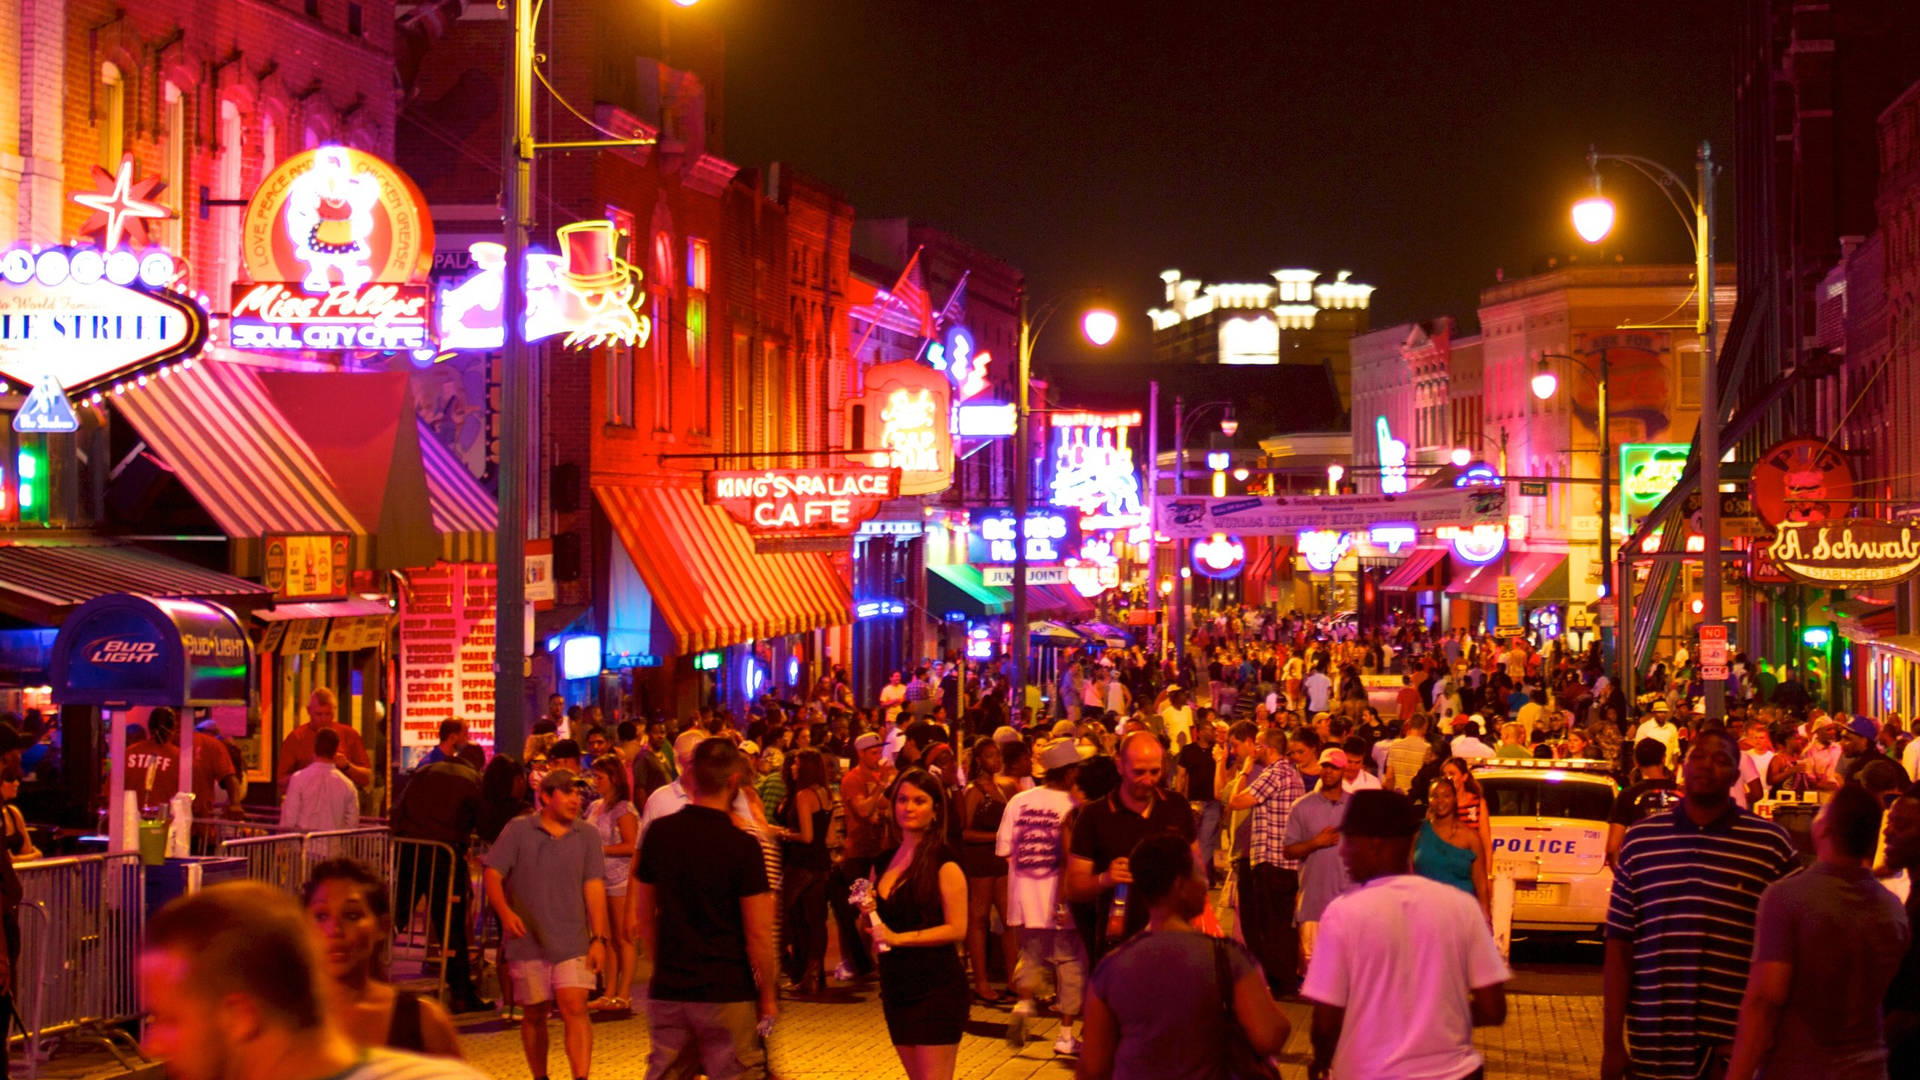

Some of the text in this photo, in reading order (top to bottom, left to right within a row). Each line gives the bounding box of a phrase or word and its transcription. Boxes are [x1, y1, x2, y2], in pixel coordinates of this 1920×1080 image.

[257, 172, 288, 223] PEACE
[356, 159, 415, 272] CHICKEN GREASE
[252, 222, 269, 269] LOVE
[53, 314, 172, 340] STREET
[232, 325, 302, 347] SOUL
[303, 325, 358, 347] CITY
[717, 473, 794, 498] KING'S
[754, 500, 852, 527] CAFE
[992, 571, 1064, 583] JUK JOINT
[1501, 589, 1517, 599] 25
[470, 625, 495, 635] FRIE
[1705, 629, 1721, 638] NO
[104, 640, 156, 652] BUD
[214, 636, 244, 658] LIGHT
[462, 637, 495, 646] PICK
[91, 652, 159, 663] LIGHT
[406, 655, 455, 665] CHICKEN
[618, 655, 654, 667] ATM
[462, 663, 494, 673] CHEES
[405, 669, 454, 679] PO-BOYS
[407, 683, 453, 693] CREOLE
[407, 693, 454, 703] WRAPS
[462, 691, 496, 701] BRIS
[406, 707, 454, 717] GUMBO
[465, 703, 495, 713] PO-B
[1492, 838, 1577, 855] POLICE
